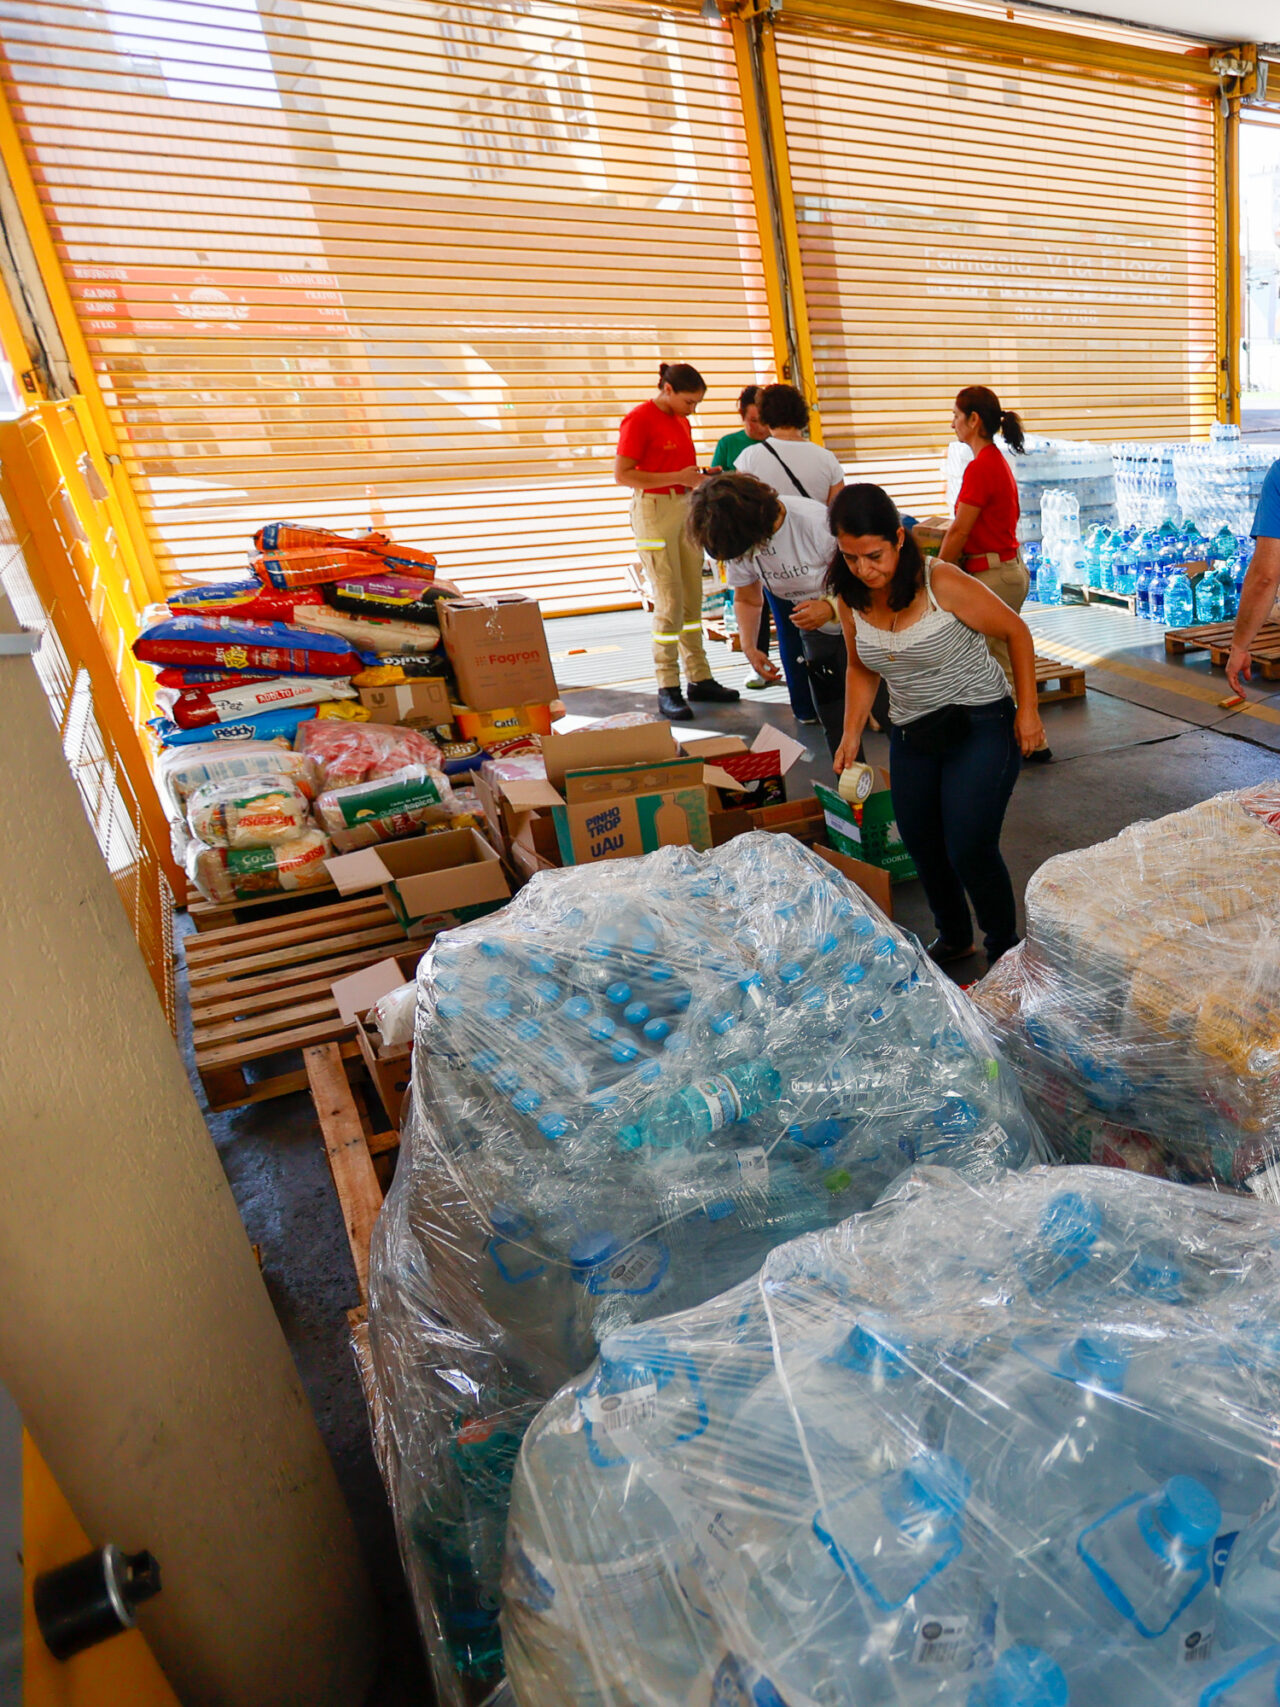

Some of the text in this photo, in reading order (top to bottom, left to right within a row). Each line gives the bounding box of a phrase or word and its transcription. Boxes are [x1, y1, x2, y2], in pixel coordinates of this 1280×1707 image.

[1042, 247, 1092, 277] Via
[489, 650, 540, 665] Fagron
[586, 806, 620, 829] PINHO
[588, 817, 621, 838] TROP
[591, 834, 625, 858] UAU
